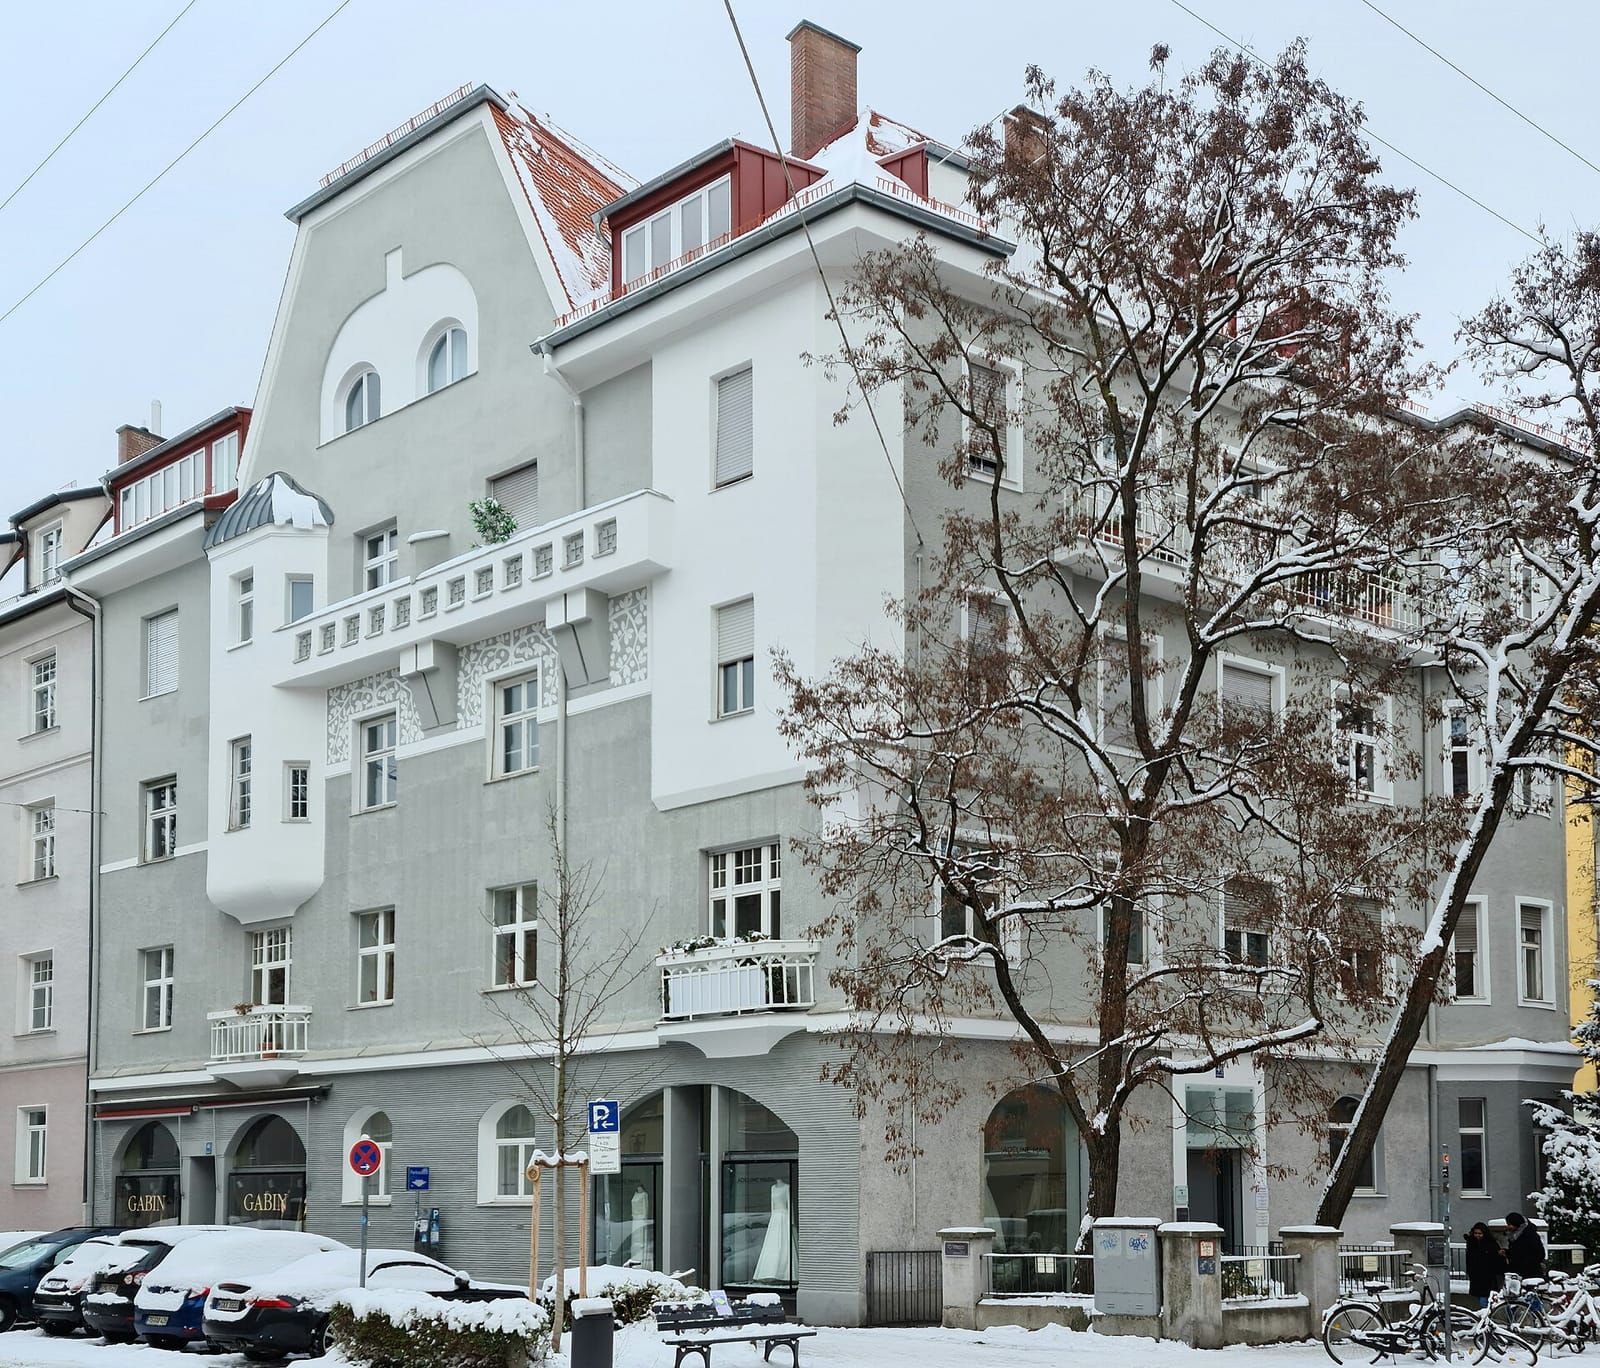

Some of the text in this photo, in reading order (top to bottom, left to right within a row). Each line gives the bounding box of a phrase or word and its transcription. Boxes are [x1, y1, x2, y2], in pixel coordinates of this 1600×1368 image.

[592, 1105, 610, 1129] P
[127, 1194, 167, 1212] GABIN
[243, 1193, 288, 1211] GABIN
[433, 1209, 439, 1220] P
